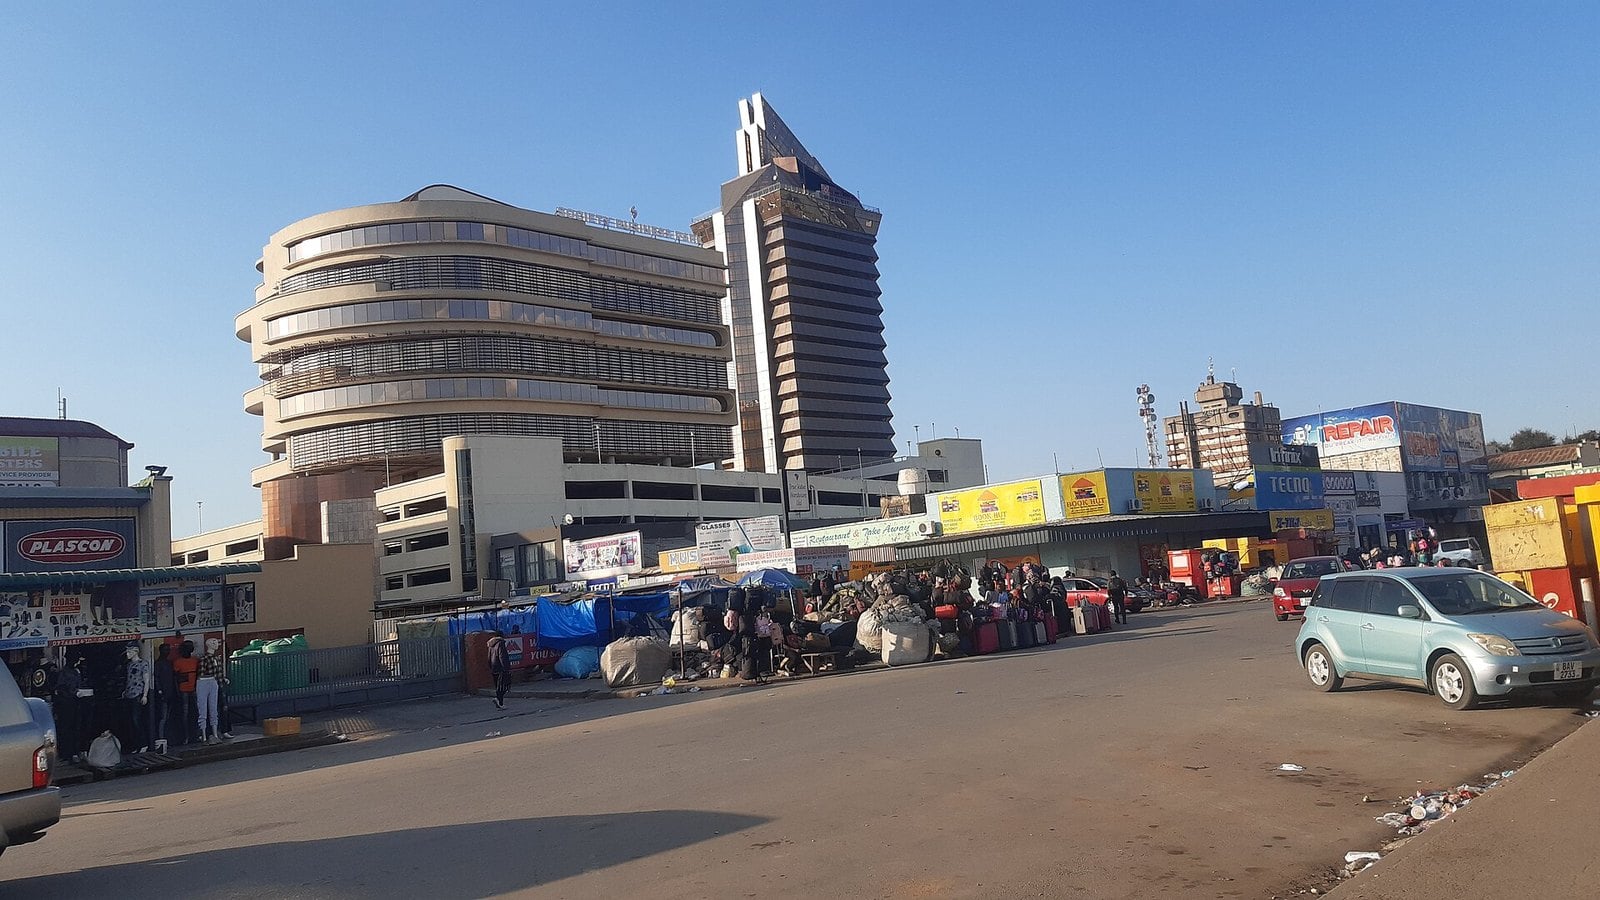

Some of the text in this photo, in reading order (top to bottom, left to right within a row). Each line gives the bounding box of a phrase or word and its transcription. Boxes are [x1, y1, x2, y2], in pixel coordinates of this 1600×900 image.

[1324, 415, 1394, 441] REPAIR
[1270, 477, 1310, 494] TECNO
[1066, 497, 1106, 508] BOOK HUT
[974, 511, 1007, 521] BOOK HUT
[701, 522, 731, 531] GLASSES
[809, 530, 850, 544] Restaurant
[853, 529, 860, 538] &
[862, 526, 881, 537] Take
[882, 524, 910, 535] Away
[30, 538, 115, 554] PLASCON
[530, 650, 549, 660] YOU
[1560, 670, 1576, 679] 2733
